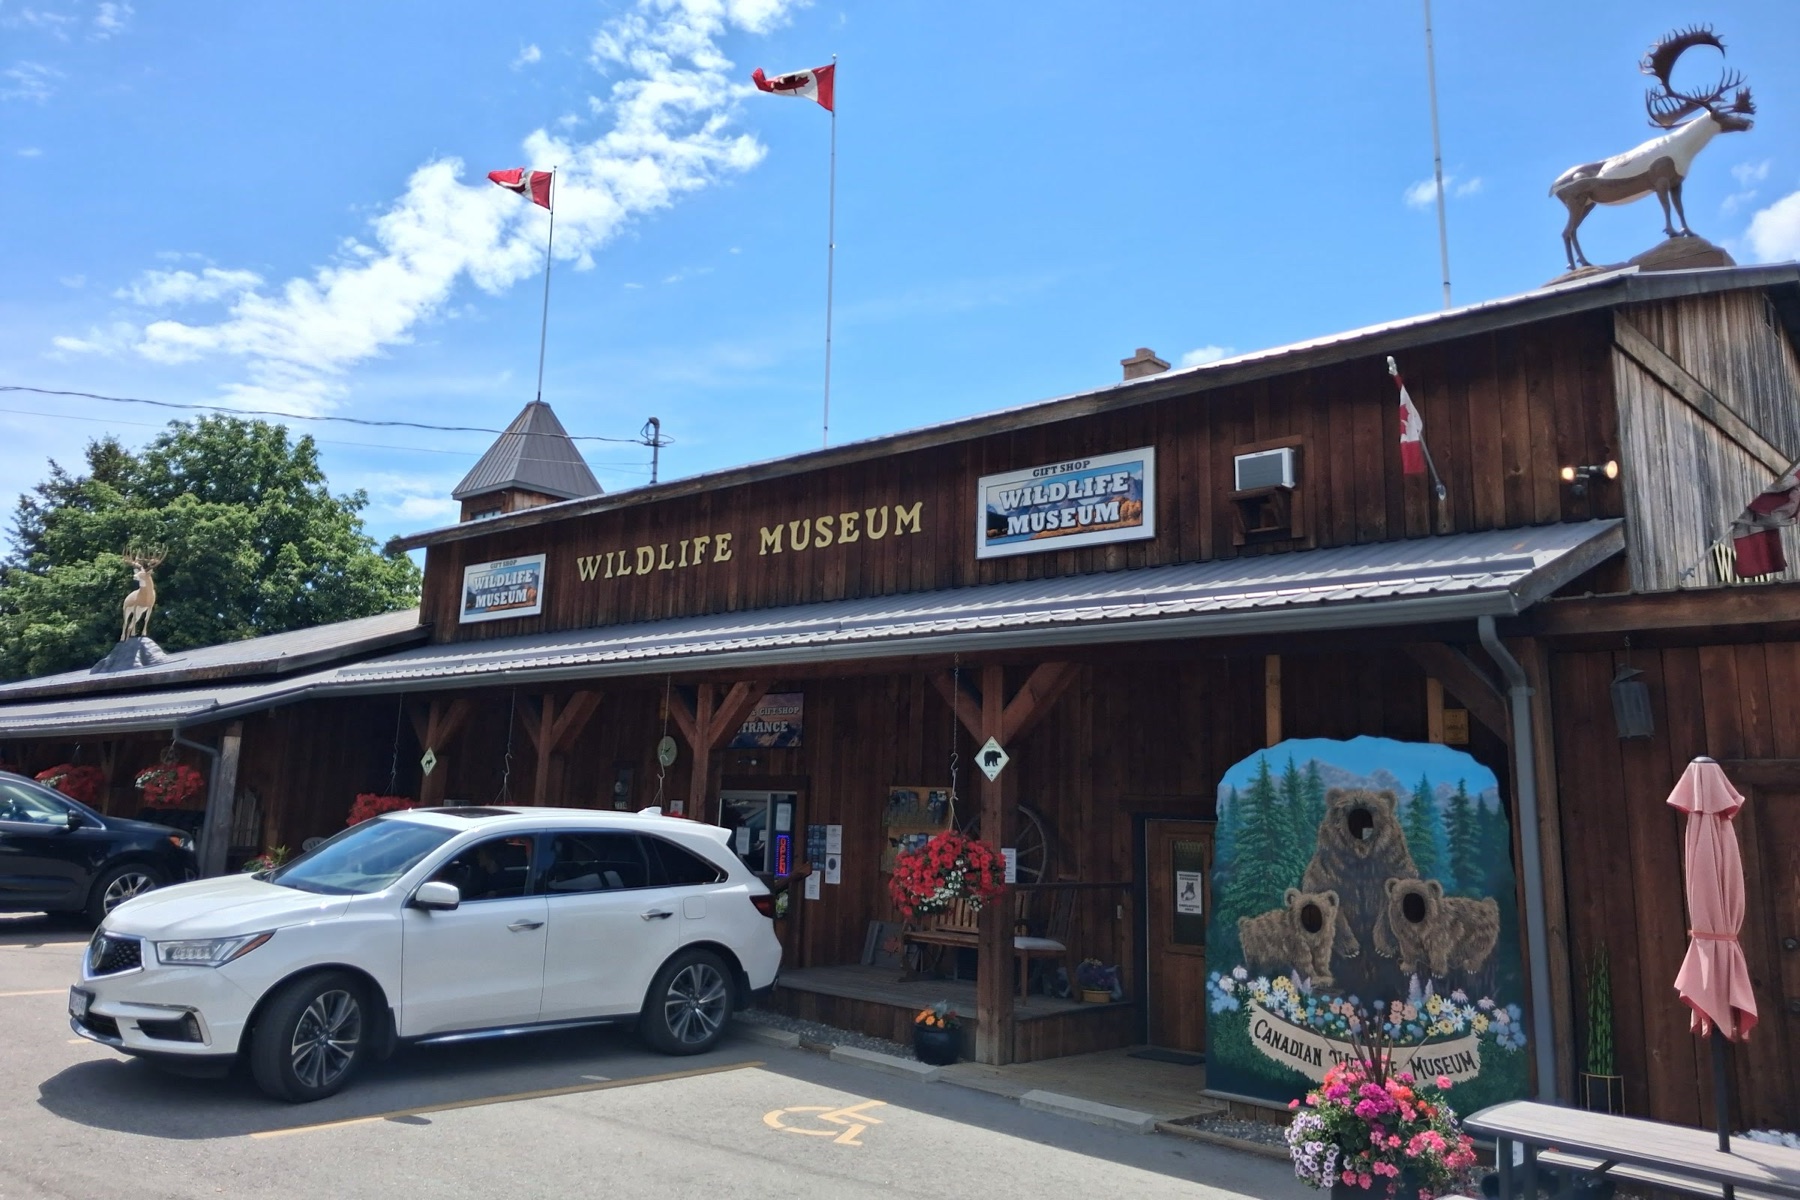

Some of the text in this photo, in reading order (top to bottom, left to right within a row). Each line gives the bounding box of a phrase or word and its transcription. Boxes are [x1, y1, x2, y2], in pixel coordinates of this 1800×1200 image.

[1033, 460, 1091, 478] GIFT SHOP
[999, 471, 1130, 511] WILDLIFE
[1007, 501, 1120, 536] MUSEUM
[577, 501, 923, 582] WILDLIFE MUSEUM
[474, 569, 534, 590] WILDLIFE
[475, 588, 528, 608] MUSEUM
[760, 707, 777, 716] GIFT
[778, 706, 800, 715] SHOP
[737, 721, 788, 733] TRANCE
[779, 837, 787, 875] OPEN
[1254, 1018, 1323, 1067] CANADIAN
[1408, 1050, 1478, 1081] MUSEUM
